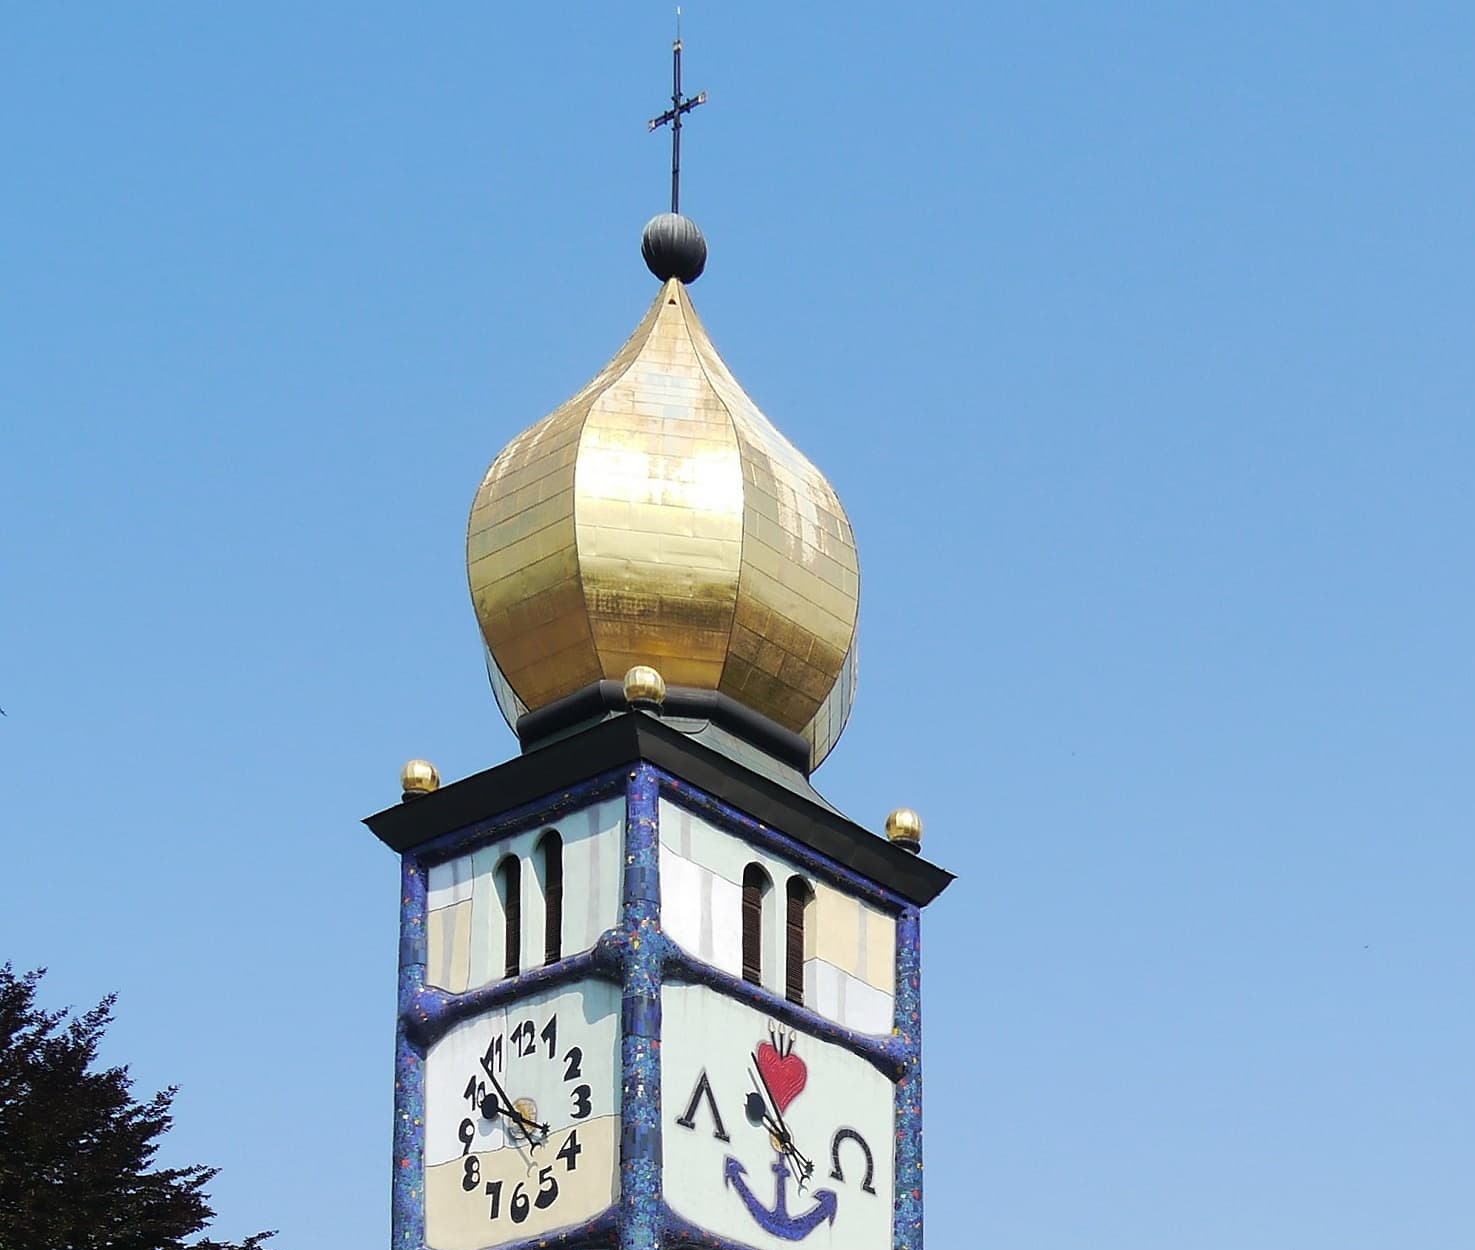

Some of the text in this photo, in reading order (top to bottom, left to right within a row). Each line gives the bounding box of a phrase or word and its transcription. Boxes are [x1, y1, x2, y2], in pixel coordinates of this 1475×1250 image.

[510, 1020, 536, 1057] 12
[541, 1013, 557, 1059] 1
[563, 1046, 582, 1081] 2
[570, 1084, 592, 1119] 3
[458, 1118, 475, 1156] 9
[556, 1129, 581, 1171] 4
[462, 1155, 480, 1192] 8
[534, 1165, 559, 1209] 5
[485, 1180, 503, 1219] 7
[510, 1182, 530, 1223] 6
